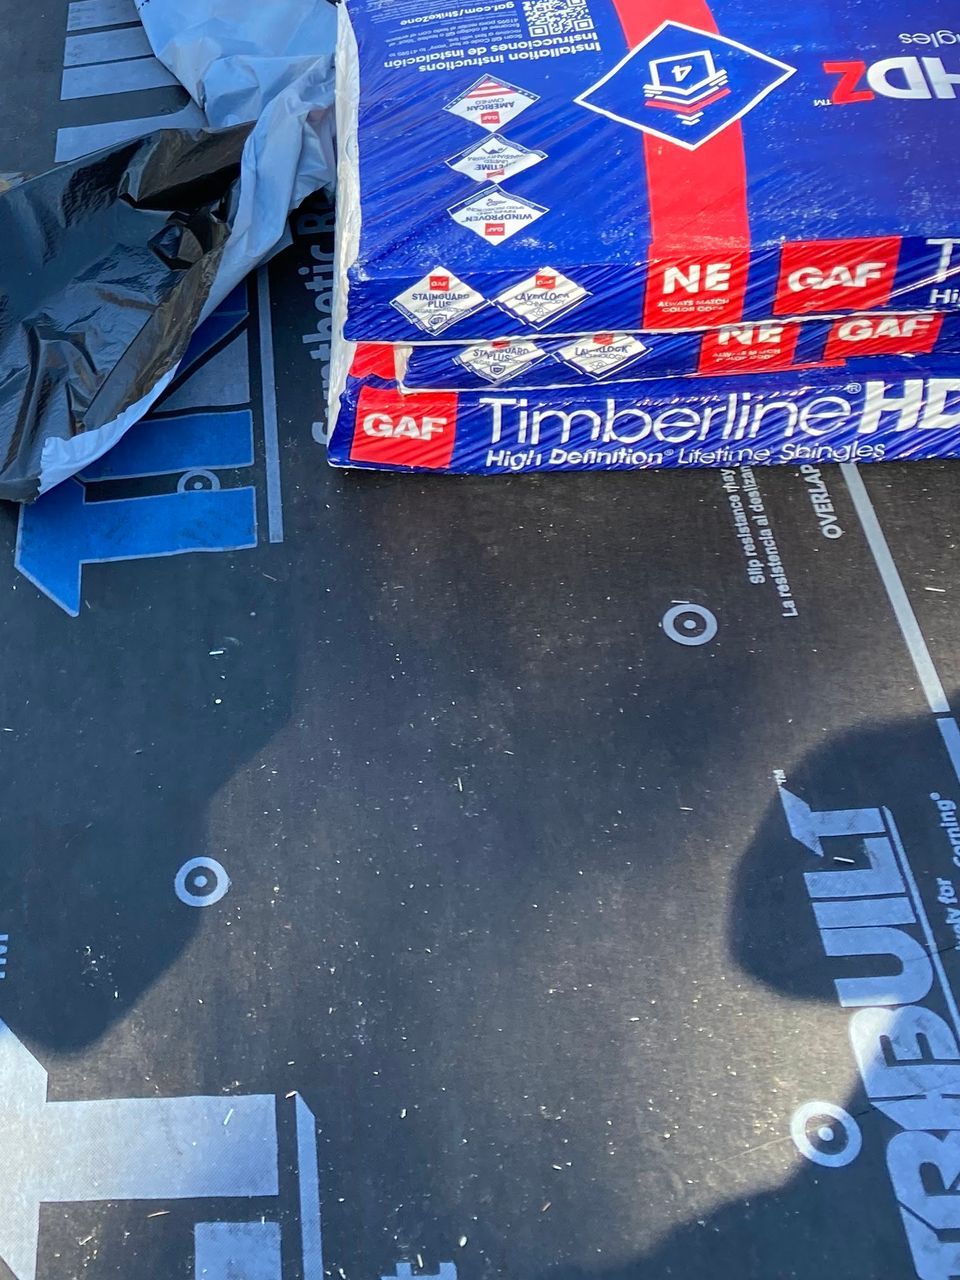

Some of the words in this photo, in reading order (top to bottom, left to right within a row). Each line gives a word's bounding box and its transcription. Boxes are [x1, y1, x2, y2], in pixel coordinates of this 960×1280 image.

[399, 0, 515, 27] gaf.com/StrikeZone
[466, 46, 487, 58] de
[489, 31, 599, 54] Instrucciones
[508, 41, 602, 62] Installation
[383, 48, 465, 70] instalación
[417, 53, 505, 74] instructions
[466, 100, 516, 112] AMERICAN
[465, 212, 533, 223] WINDPROVEN
[661, 262, 732, 295] NE
[788, 261, 887, 293] GAF
[717, 326, 784, 346] NE
[837, 314, 934, 342] GAF
[362, 412, 448, 441] GAF
[479, 392, 852, 445] Timberline
[486, 448, 542, 470] High
[677, 444, 771, 465] Lifetime
[780, 441, 886, 466] Shingles
[799, 463, 844, 540] OVERLAP
[728, 493, 758, 558] resistance
[751, 514, 769, 527] al
[746, 558, 767, 585] Slip
[758, 528, 793, 598] resistencia
[781, 599, 800, 618] La
